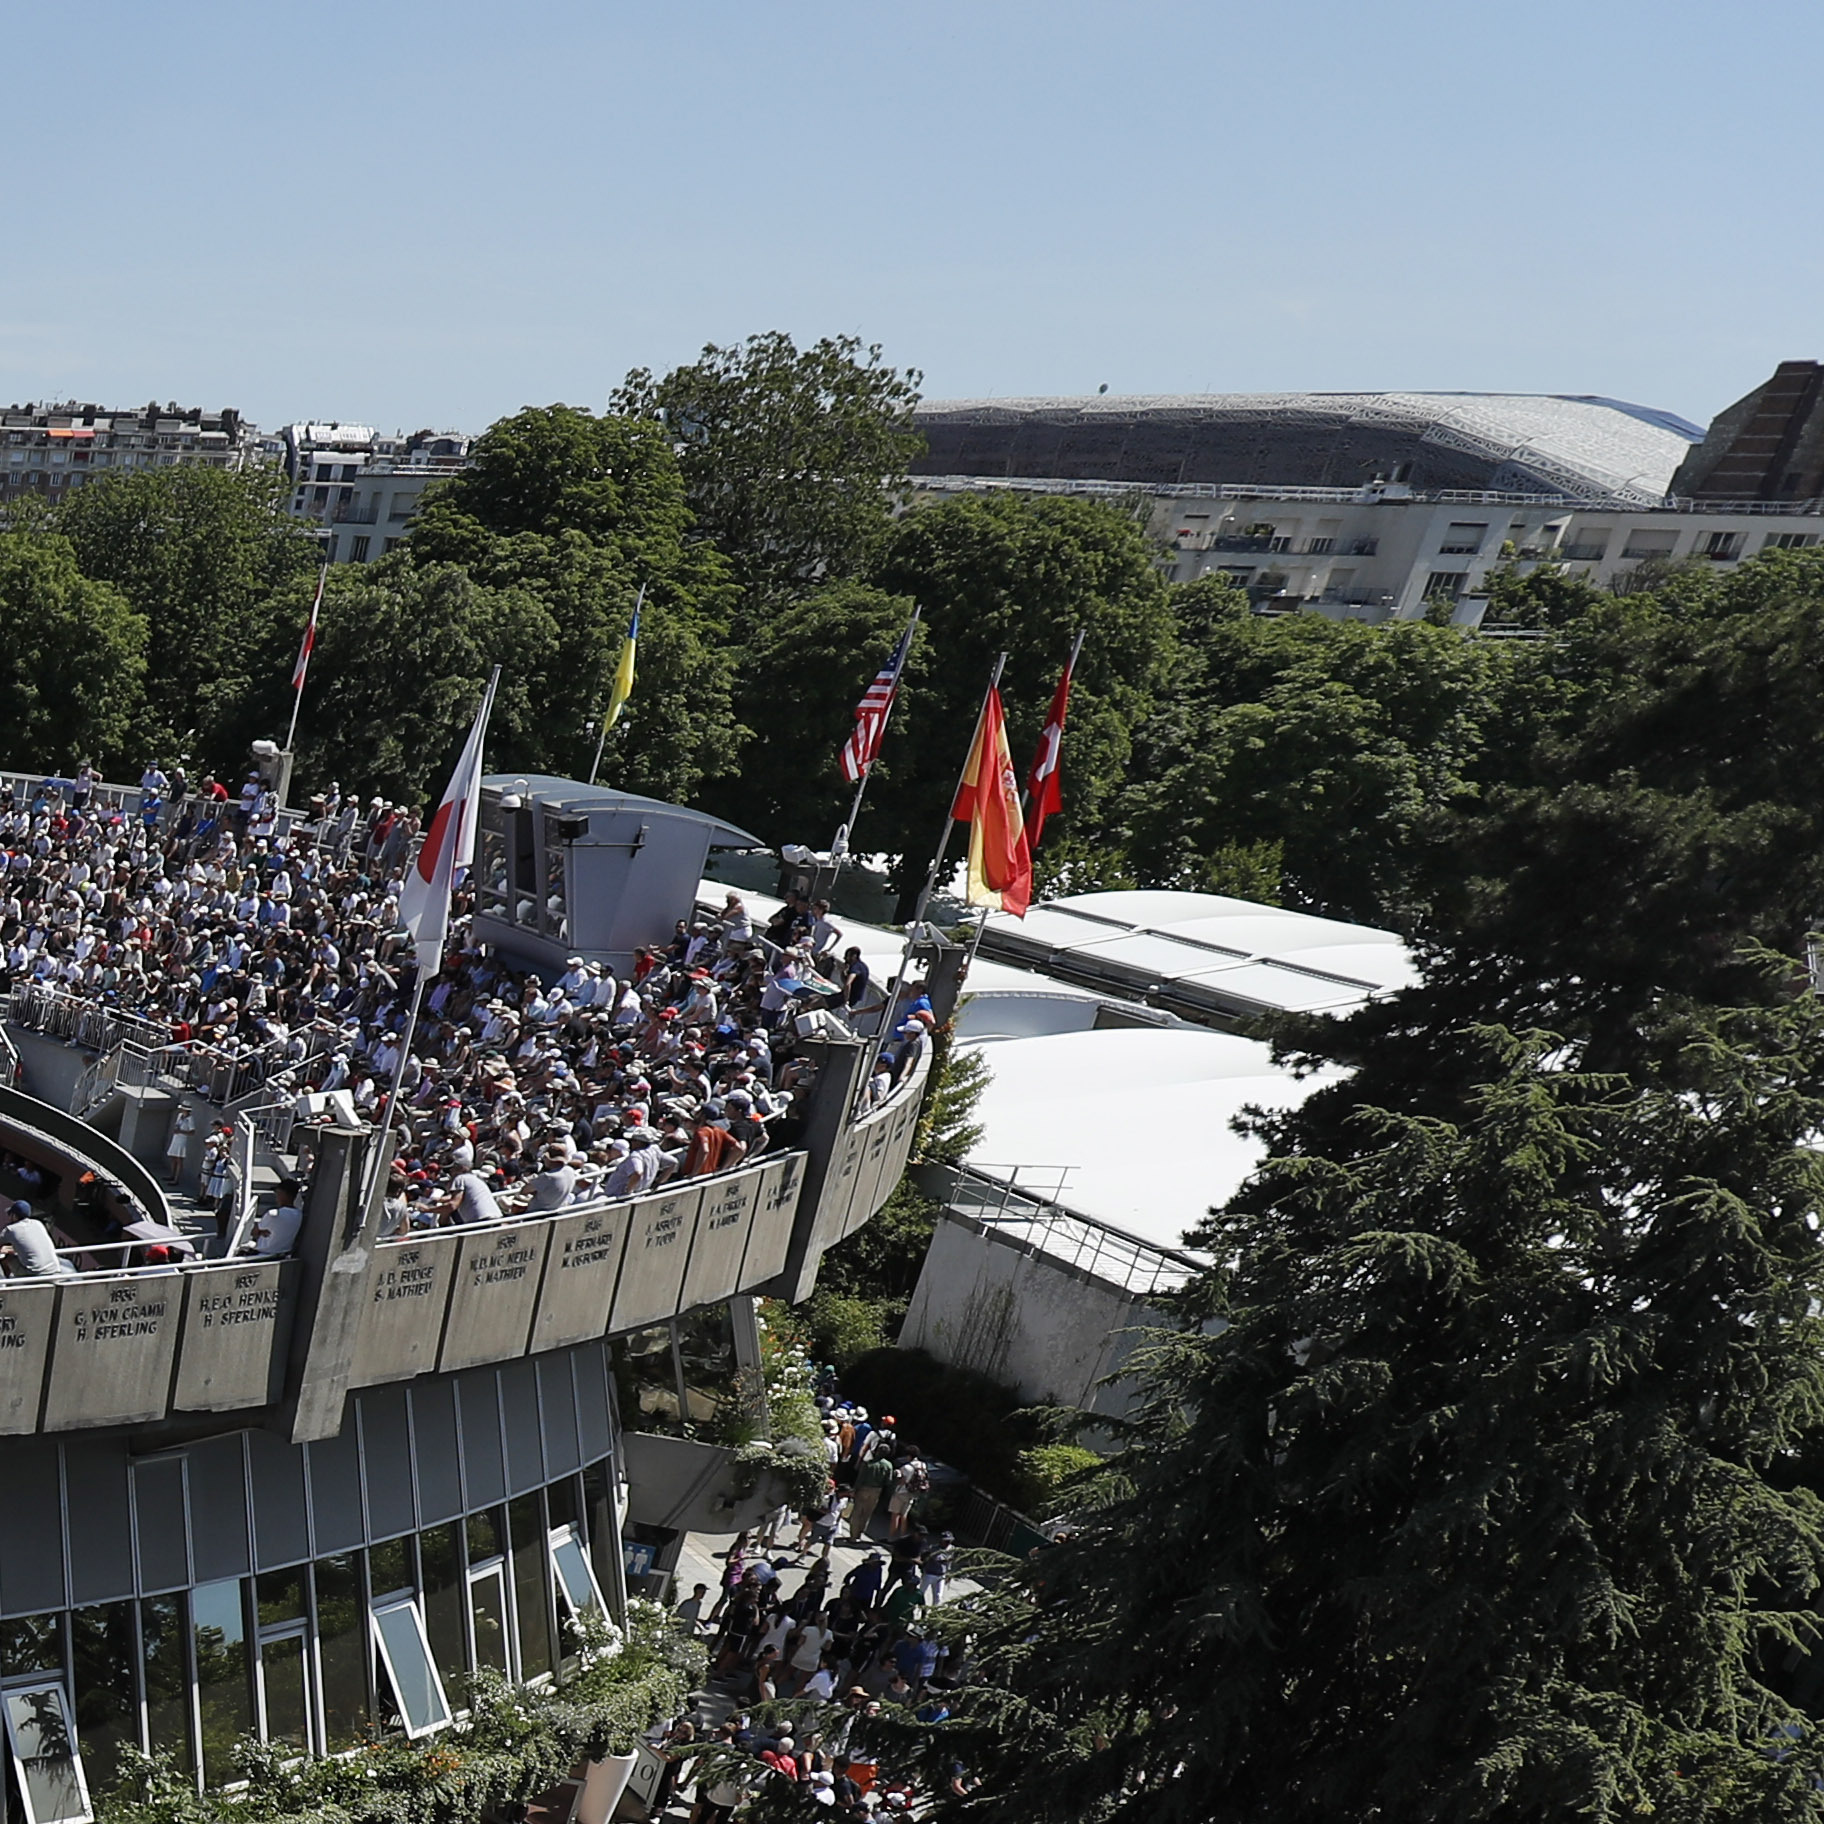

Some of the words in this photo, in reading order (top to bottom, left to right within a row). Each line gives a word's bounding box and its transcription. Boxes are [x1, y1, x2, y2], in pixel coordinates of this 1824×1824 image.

[486, 1265, 527, 1284] MATHIEU
[387, 1280, 433, 1301] MATHIEU
[92, 1308, 119, 1325] VON
[122, 1301, 167, 1320] CRAMM
